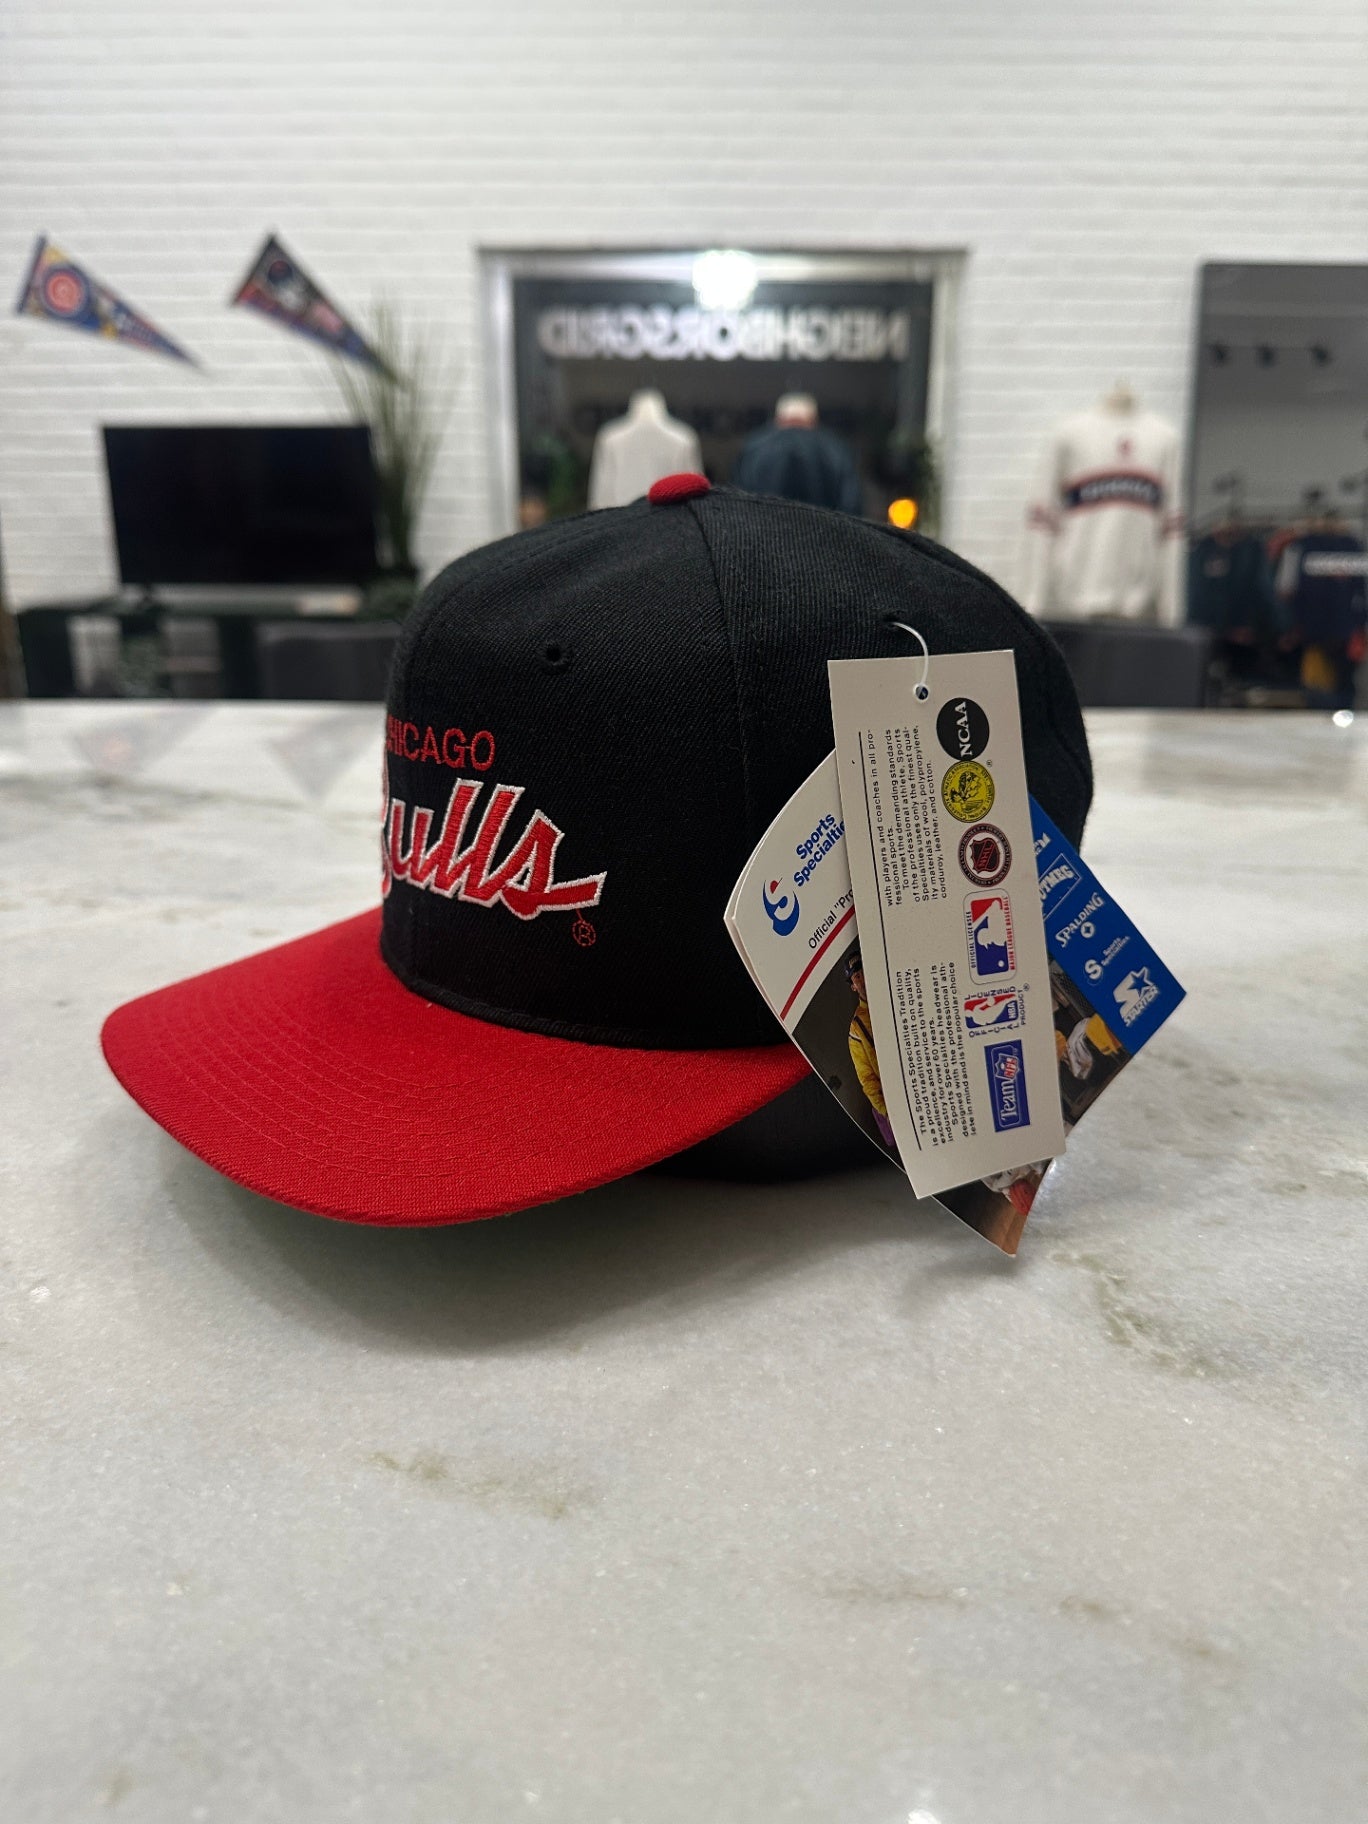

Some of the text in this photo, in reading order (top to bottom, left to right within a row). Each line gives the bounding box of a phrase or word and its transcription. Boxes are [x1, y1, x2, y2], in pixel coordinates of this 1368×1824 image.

[387, 714, 495, 771] HICAGO
[894, 728, 904, 763] Sports
[955, 701, 973, 758] NCAA
[868, 752, 876, 764] all
[884, 729, 896, 778] standards
[905, 753, 915, 780] finest
[870, 768, 877, 777] in
[872, 780, 882, 822] coaches
[891, 779, 902, 833] demanding
[909, 783, 917, 799] the
[928, 796, 936, 813] and
[911, 801, 919, 820] only
[796, 814, 835, 859] Sports
[876, 825, 885, 843] and
[902, 806, 917, 869] professional
[914, 822, 922, 845] uses
[922, 826, 930, 836] of
[383, 777, 607, 920] ulls
[794, 820, 845, 887] Specialti
[880, 846, 891, 882] players
[898, 852, 907, 877] meet
[924, 839, 936, 884] materials
[890, 860, 902, 905] fessional
[901, 878, 909, 890] To
[917, 846, 929, 901] Specialties
[1039, 865, 1075, 900] UTMEG
[884, 885, 892, 906] with
[912, 892, 920, 902] of
[808, 890, 837, 949] Official
[1055, 892, 1104, 948] SPALDING
[913, 967, 922, 999] sports
[948, 961, 957, 994] choice
[909, 1008, 916, 1021] on
[940, 985, 956, 1045] professional
[951, 995, 962, 1032] popular
[1006, 1001, 1017, 1019] NBA
[1123, 983, 1159, 1027] STARTER
[910, 1023, 920, 1047] built
[919, 1019, 926, 1029] to
[895, 971, 926, 1134] The Sports Specialties Tradition
[921, 1031, 931, 1067] service
[930, 964, 958, 1125] Sports Specialties headwear is
[931, 1048, 939, 1061] 60
[958, 1051, 964, 1059] is
[915, 1049, 926, 1094] tradition
[925, 1068, 934, 1086] and
[934, 1063, 942, 1084] over
[952, 1068, 960, 1089] with
[959, 1061, 967, 1079] and
[961, 1080, 971, 1104] mind
[995, 1055, 1019, 1121] Team NFL
[921, 1095, 935, 1125] proud
[940, 1101, 953, 1142] industry
[955, 1092, 968, 1137] designed
[966, 1105, 973, 1115] in
[932, 1136, 938, 1146] is
